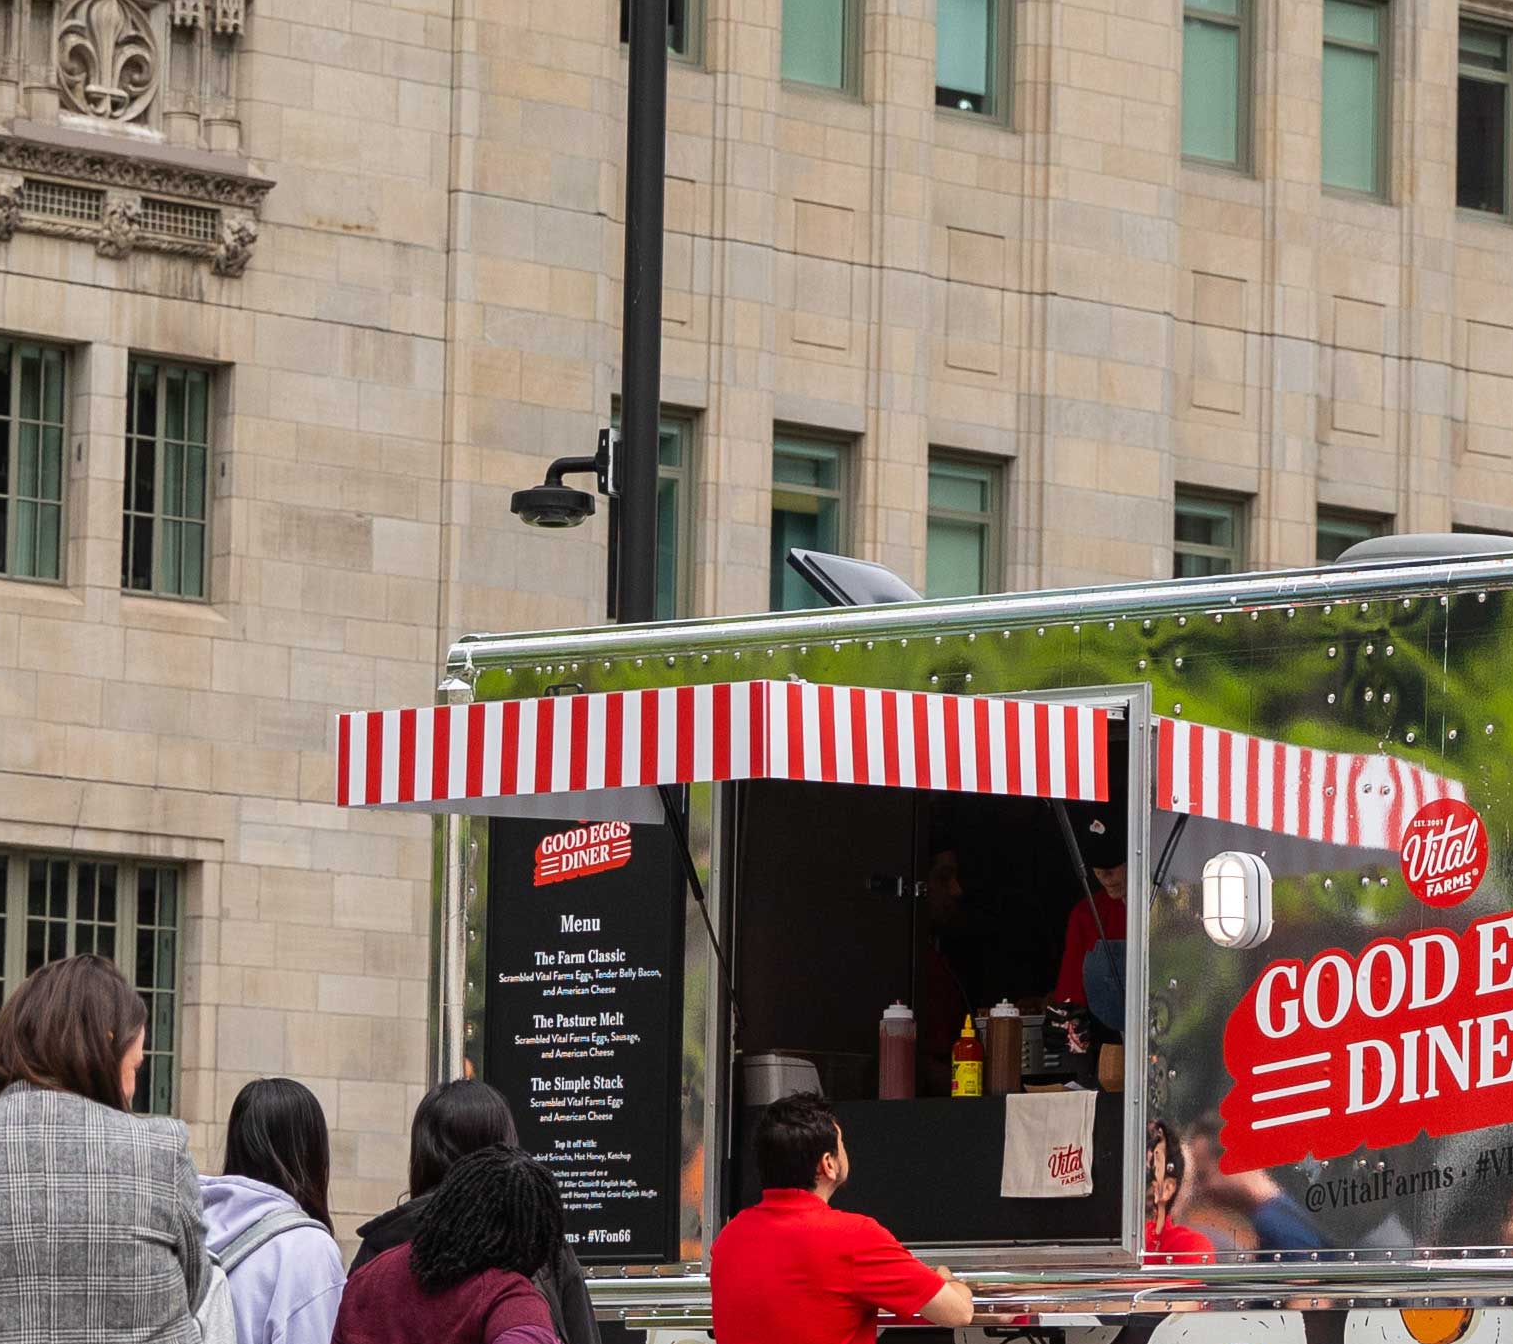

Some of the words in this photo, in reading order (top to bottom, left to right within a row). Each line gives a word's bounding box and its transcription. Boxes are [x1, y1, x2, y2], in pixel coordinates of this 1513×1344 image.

[541, 828, 587, 855] GOOD
[590, 820, 631, 843] EGGS
[1403, 814, 1478, 881] Vital
[561, 845, 610, 872] DINER
[561, 915, 600, 932] Menu
[535, 951, 555, 965] The
[558, 951, 585, 964] Farm
[588, 948, 626, 963] Classic
[499, 973, 534, 983] Scrambled
[536, 972, 551, 981] Vital
[553, 971, 573, 980] Farms
[575, 970, 593, 982] Eggs,
[595, 969, 618, 979] Tender
[620, 968, 636, 980] Belly
[638, 967, 662, 978] Bacon,
[543, 987, 555, 996] and
[557, 986, 589, 995] American
[591, 985, 615, 994] Cheese
[1255, 934, 1459, 1038] GOOD
[533, 1014, 553, 1028] The
[557, 1014, 597, 1027] Pasture
[600, 1012, 624, 1026] Melt
[515, 1035, 550, 1045] Scrambled
[552, 1034, 568, 1043] Vital
[569, 1033, 589, 1043] Farms
[592, 1033, 609, 1045] Eggs,
[611, 1032, 640, 1044] Sausage,
[542, 1049, 554, 1059] and
[555, 1049, 587, 1058] American
[589, 1047, 614, 1057] Cheese
[531, 1077, 551, 1091] The
[554, 1076, 590, 1093] Simple
[594, 1075, 624, 1089] Stack
[530, 1097, 565, 1107] Scrambled
[567, 1097, 583, 1106] Vital
[585, 1096, 605, 1106] Farms
[607, 1095, 623, 1108] Eggs
[540, 1113, 552, 1122] and
[554, 1112, 586, 1122] American
[588, 1111, 613, 1121] Cheese
[574, 1153, 585, 1161] Hot
[608, 1152, 631, 1162] Ketchup
[1048, 1143, 1083, 1178] Vital
[1061, 1172, 1085, 1186] FARMS
[1304, 1163, 1454, 1214] @VitalFarms
[588, 1229, 631, 1243] #VFon66
